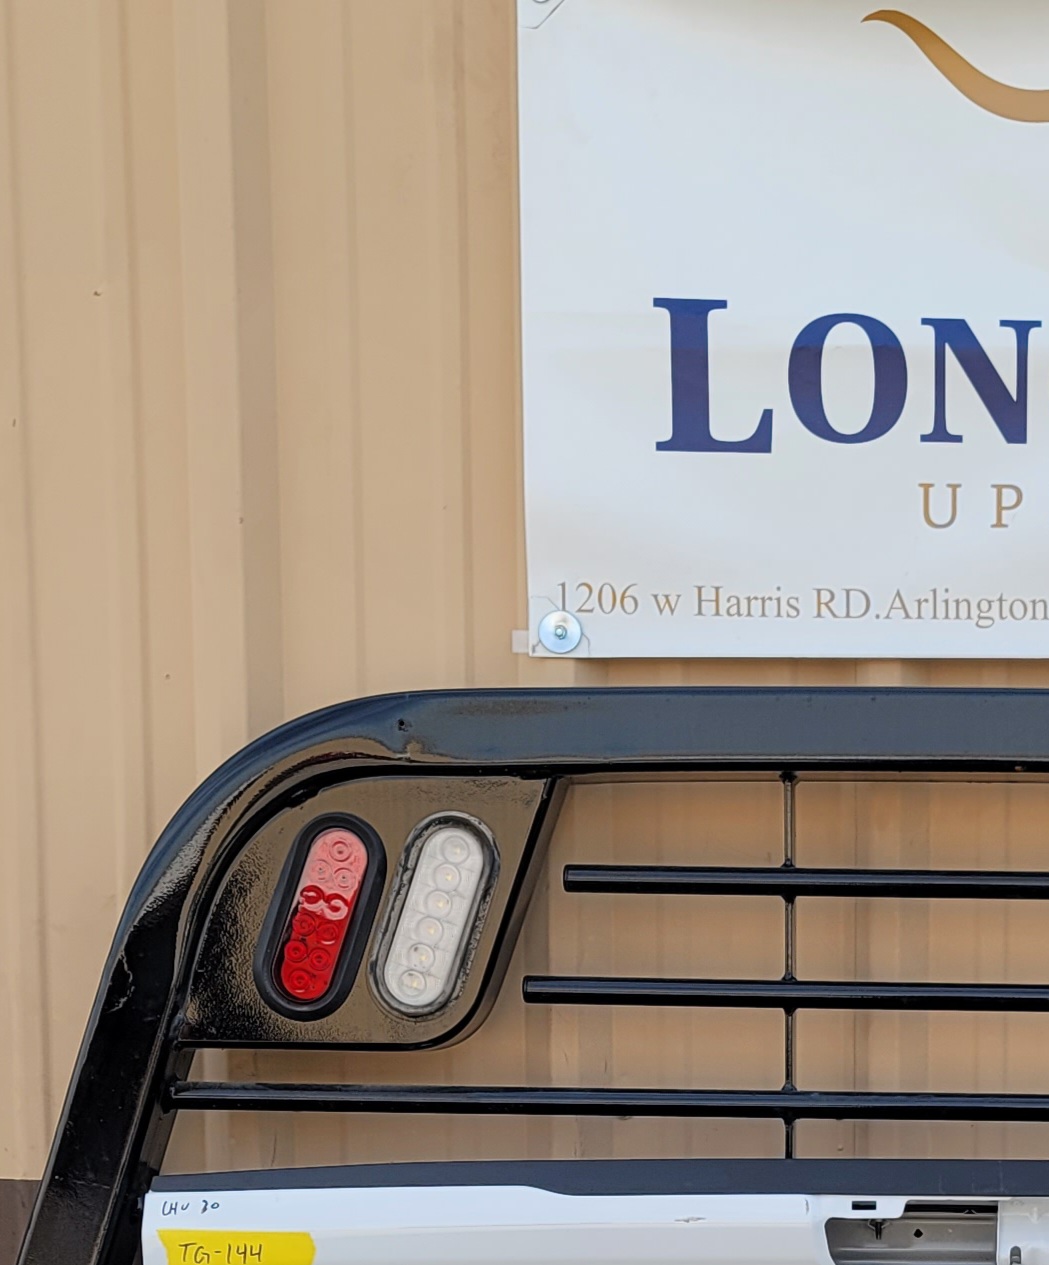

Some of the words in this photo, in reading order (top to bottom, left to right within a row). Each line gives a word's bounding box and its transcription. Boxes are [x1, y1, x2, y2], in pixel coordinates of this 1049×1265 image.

[556, 580, 639, 615] 1206
[693, 583, 801, 620] Harris
[178, 1241, 263, 1265] TG-144
